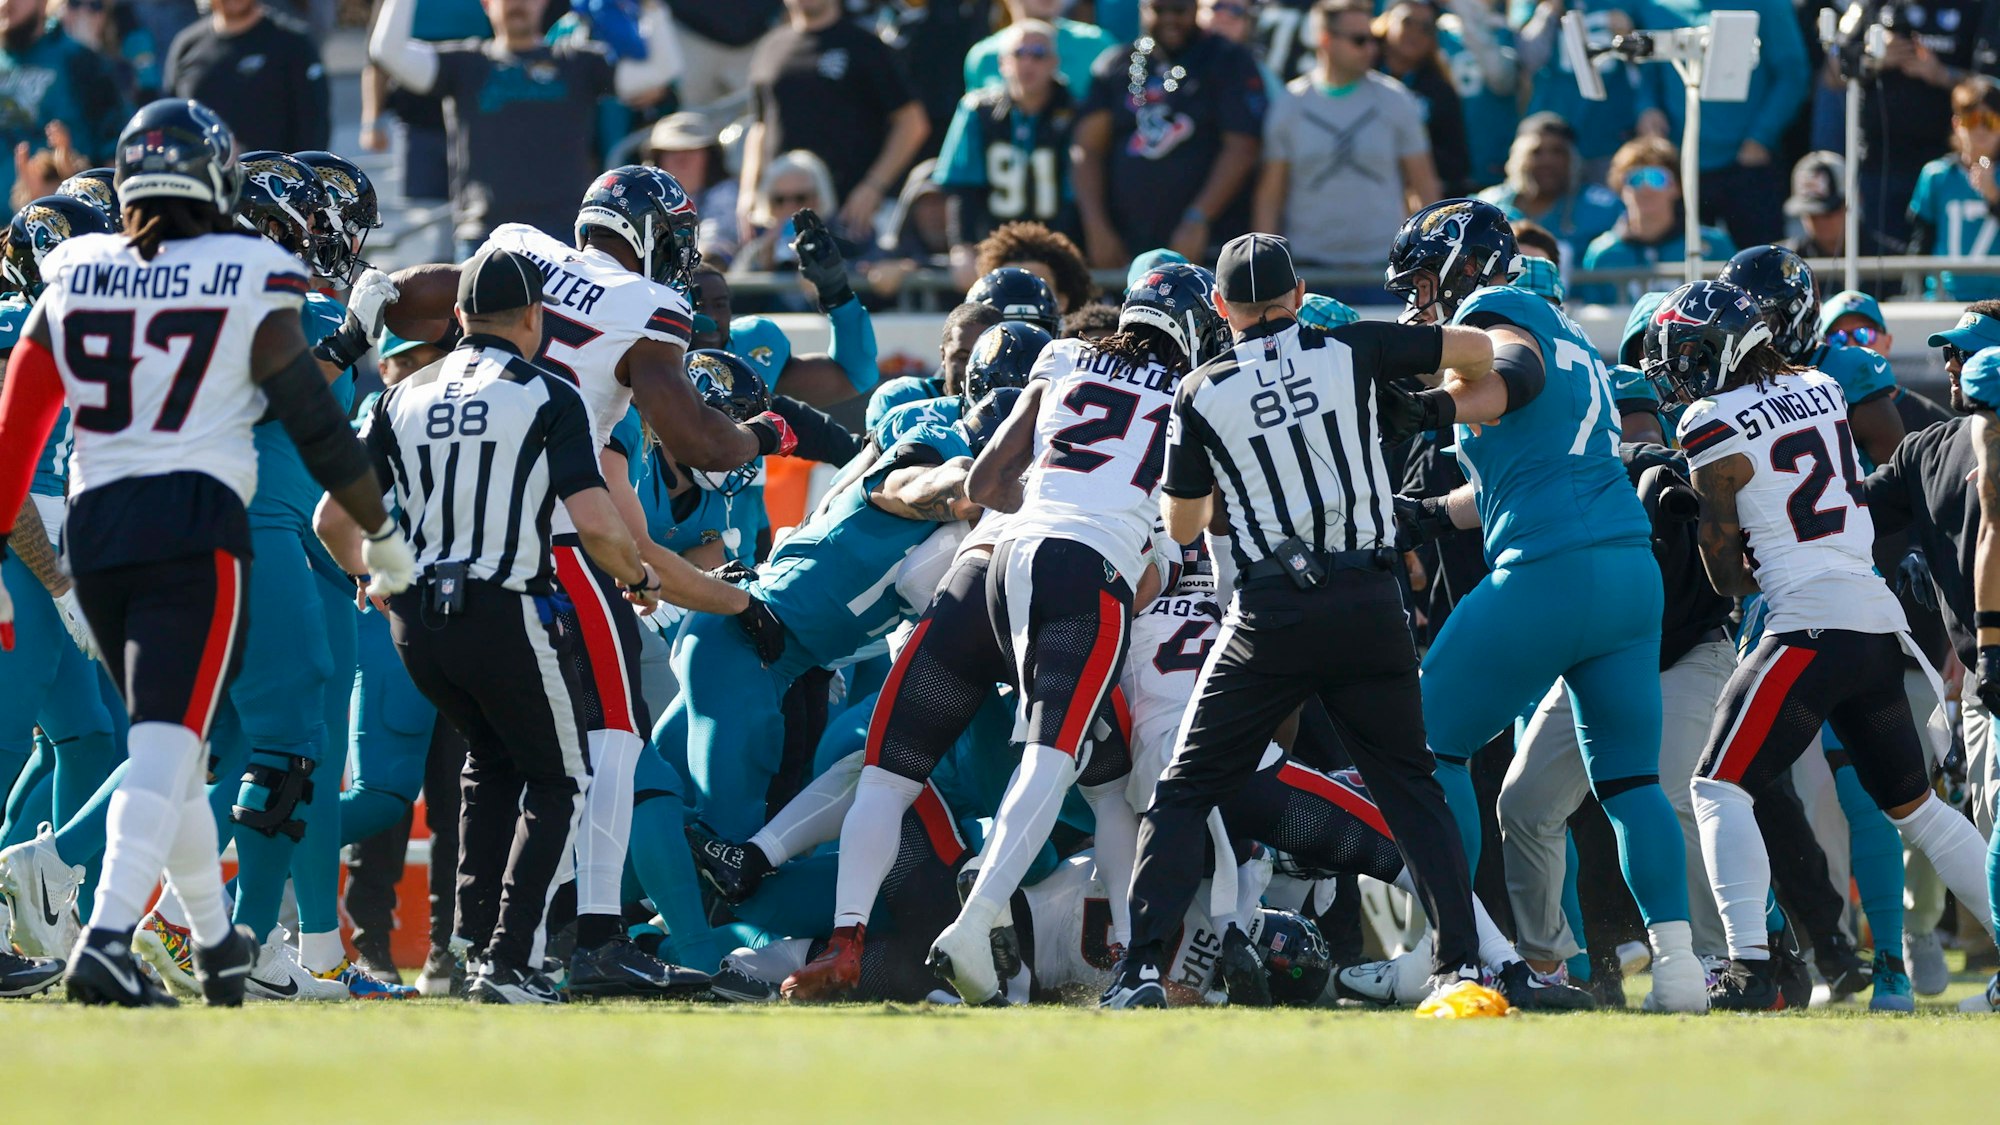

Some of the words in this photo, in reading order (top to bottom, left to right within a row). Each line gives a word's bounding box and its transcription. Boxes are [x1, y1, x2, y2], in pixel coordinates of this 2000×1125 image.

[986, 141, 1057, 219] 91
[581, 208, 617, 218] HOUSTON
[1945, 199, 1999, 261] 17
[70, 261, 191, 299] DWARDS
[201, 262, 243, 297] JR
[520, 249, 606, 316] NTER
[63, 307, 230, 435] 97
[1256, 358, 1296, 388] LJ
[425, 400, 489, 440] 88
[1250, 376, 1320, 429] 85
[1735, 384, 1838, 441] STINGLEY
[1040, 381, 1173, 496] 21
[1769, 418, 1869, 543] 24
[1152, 619, 1216, 688] 4
